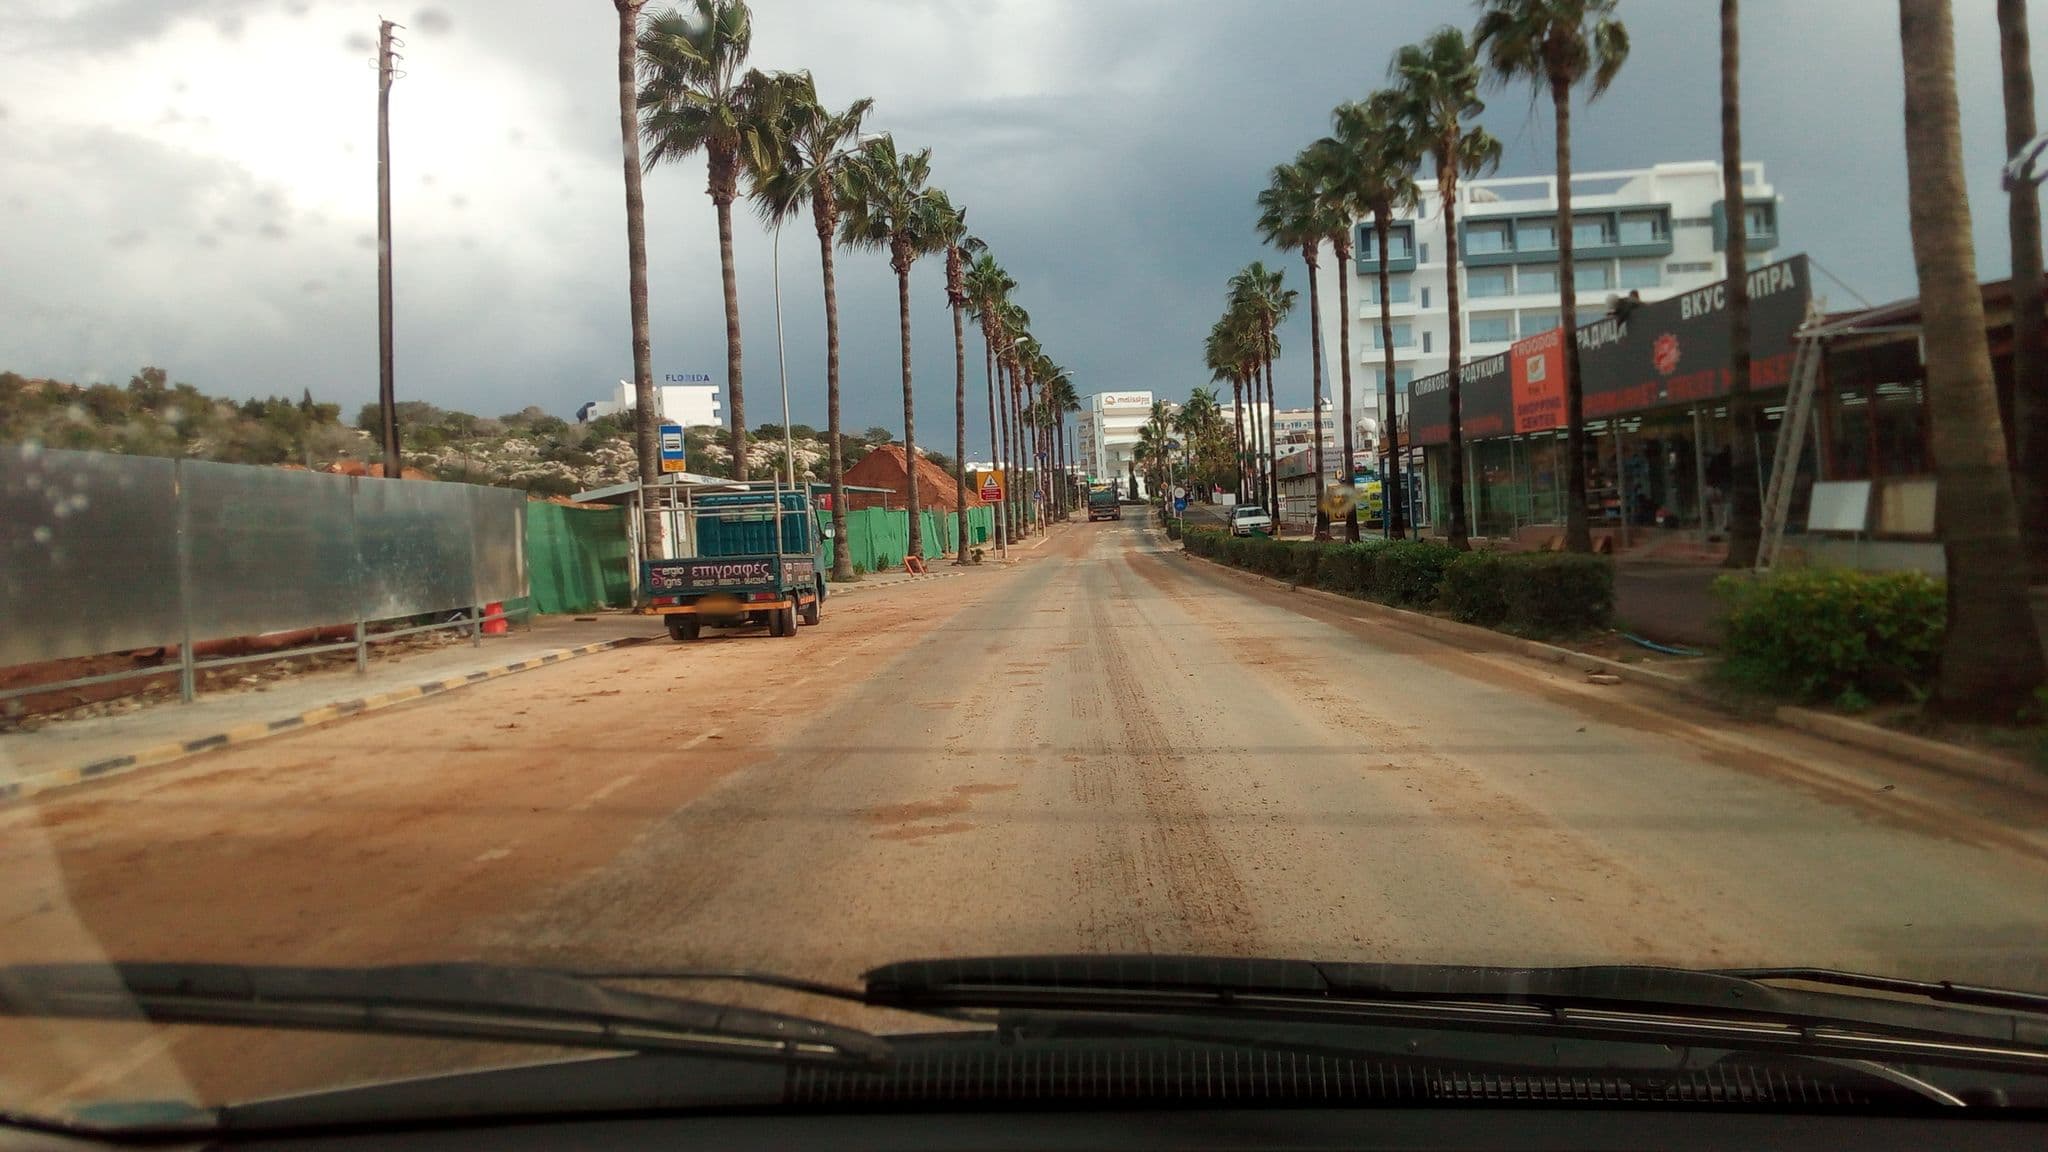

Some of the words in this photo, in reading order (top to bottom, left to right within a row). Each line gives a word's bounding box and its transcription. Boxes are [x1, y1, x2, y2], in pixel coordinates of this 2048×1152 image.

[1681, 284, 1726, 320] ВКУС
[1746, 262, 1795, 300] ИПРА
[665, 374, 710, 382] FLORIDA
[1459, 355, 1505, 384] РОДУКЦИЯ
[691, 562, 769, 579] επιγραφές
